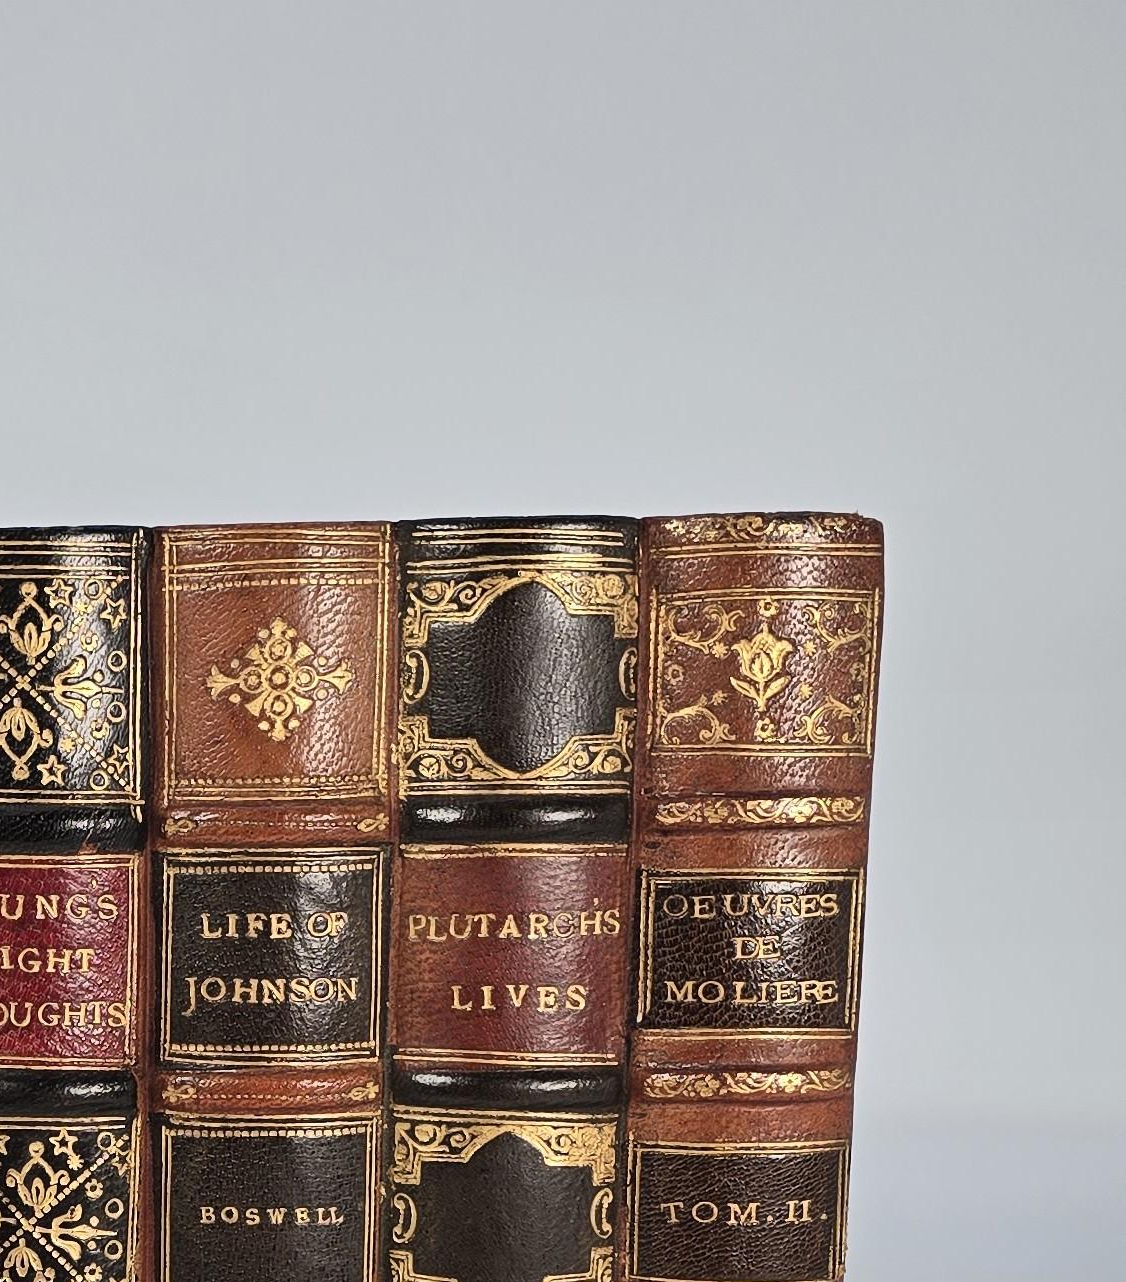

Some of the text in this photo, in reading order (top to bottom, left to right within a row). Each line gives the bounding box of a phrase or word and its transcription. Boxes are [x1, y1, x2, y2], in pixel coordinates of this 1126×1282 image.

[663, 893, 839, 919] OEUVRES
[199, 911, 349, 939] LIFE OF
[408, 899, 621, 942] PLUTARCH'S
[732, 935, 782, 960] DE
[184, 977, 359, 1016] JOHNSON
[451, 984, 587, 1012] LIVES
[663, 980, 839, 1005] MOLIERE
[200, 1206, 345, 1226] BOSWELL
